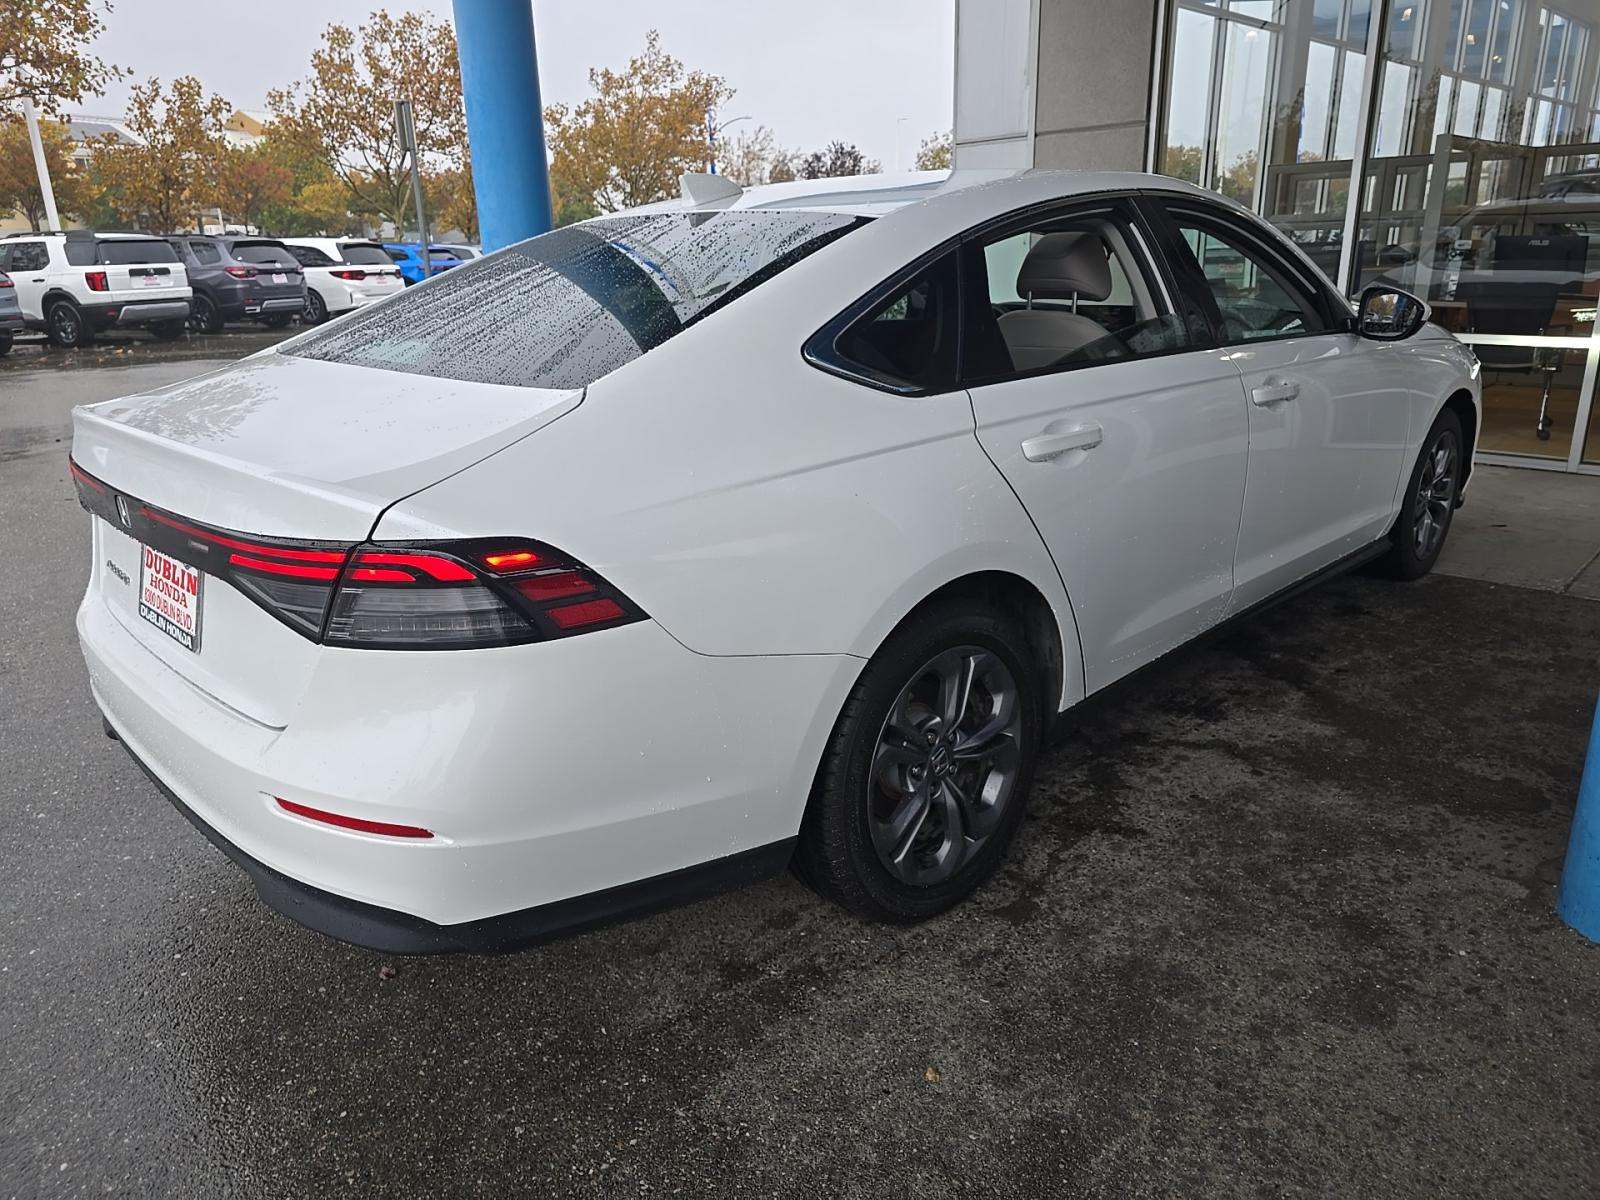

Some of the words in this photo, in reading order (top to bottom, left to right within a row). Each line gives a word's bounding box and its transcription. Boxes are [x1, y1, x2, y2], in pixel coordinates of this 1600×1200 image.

[145, 549, 197, 596] DUBLIN
[150, 573, 188, 608] HONDA
[140, 605, 166, 631] DUBLIN
[166, 622, 192, 649] HONDA
